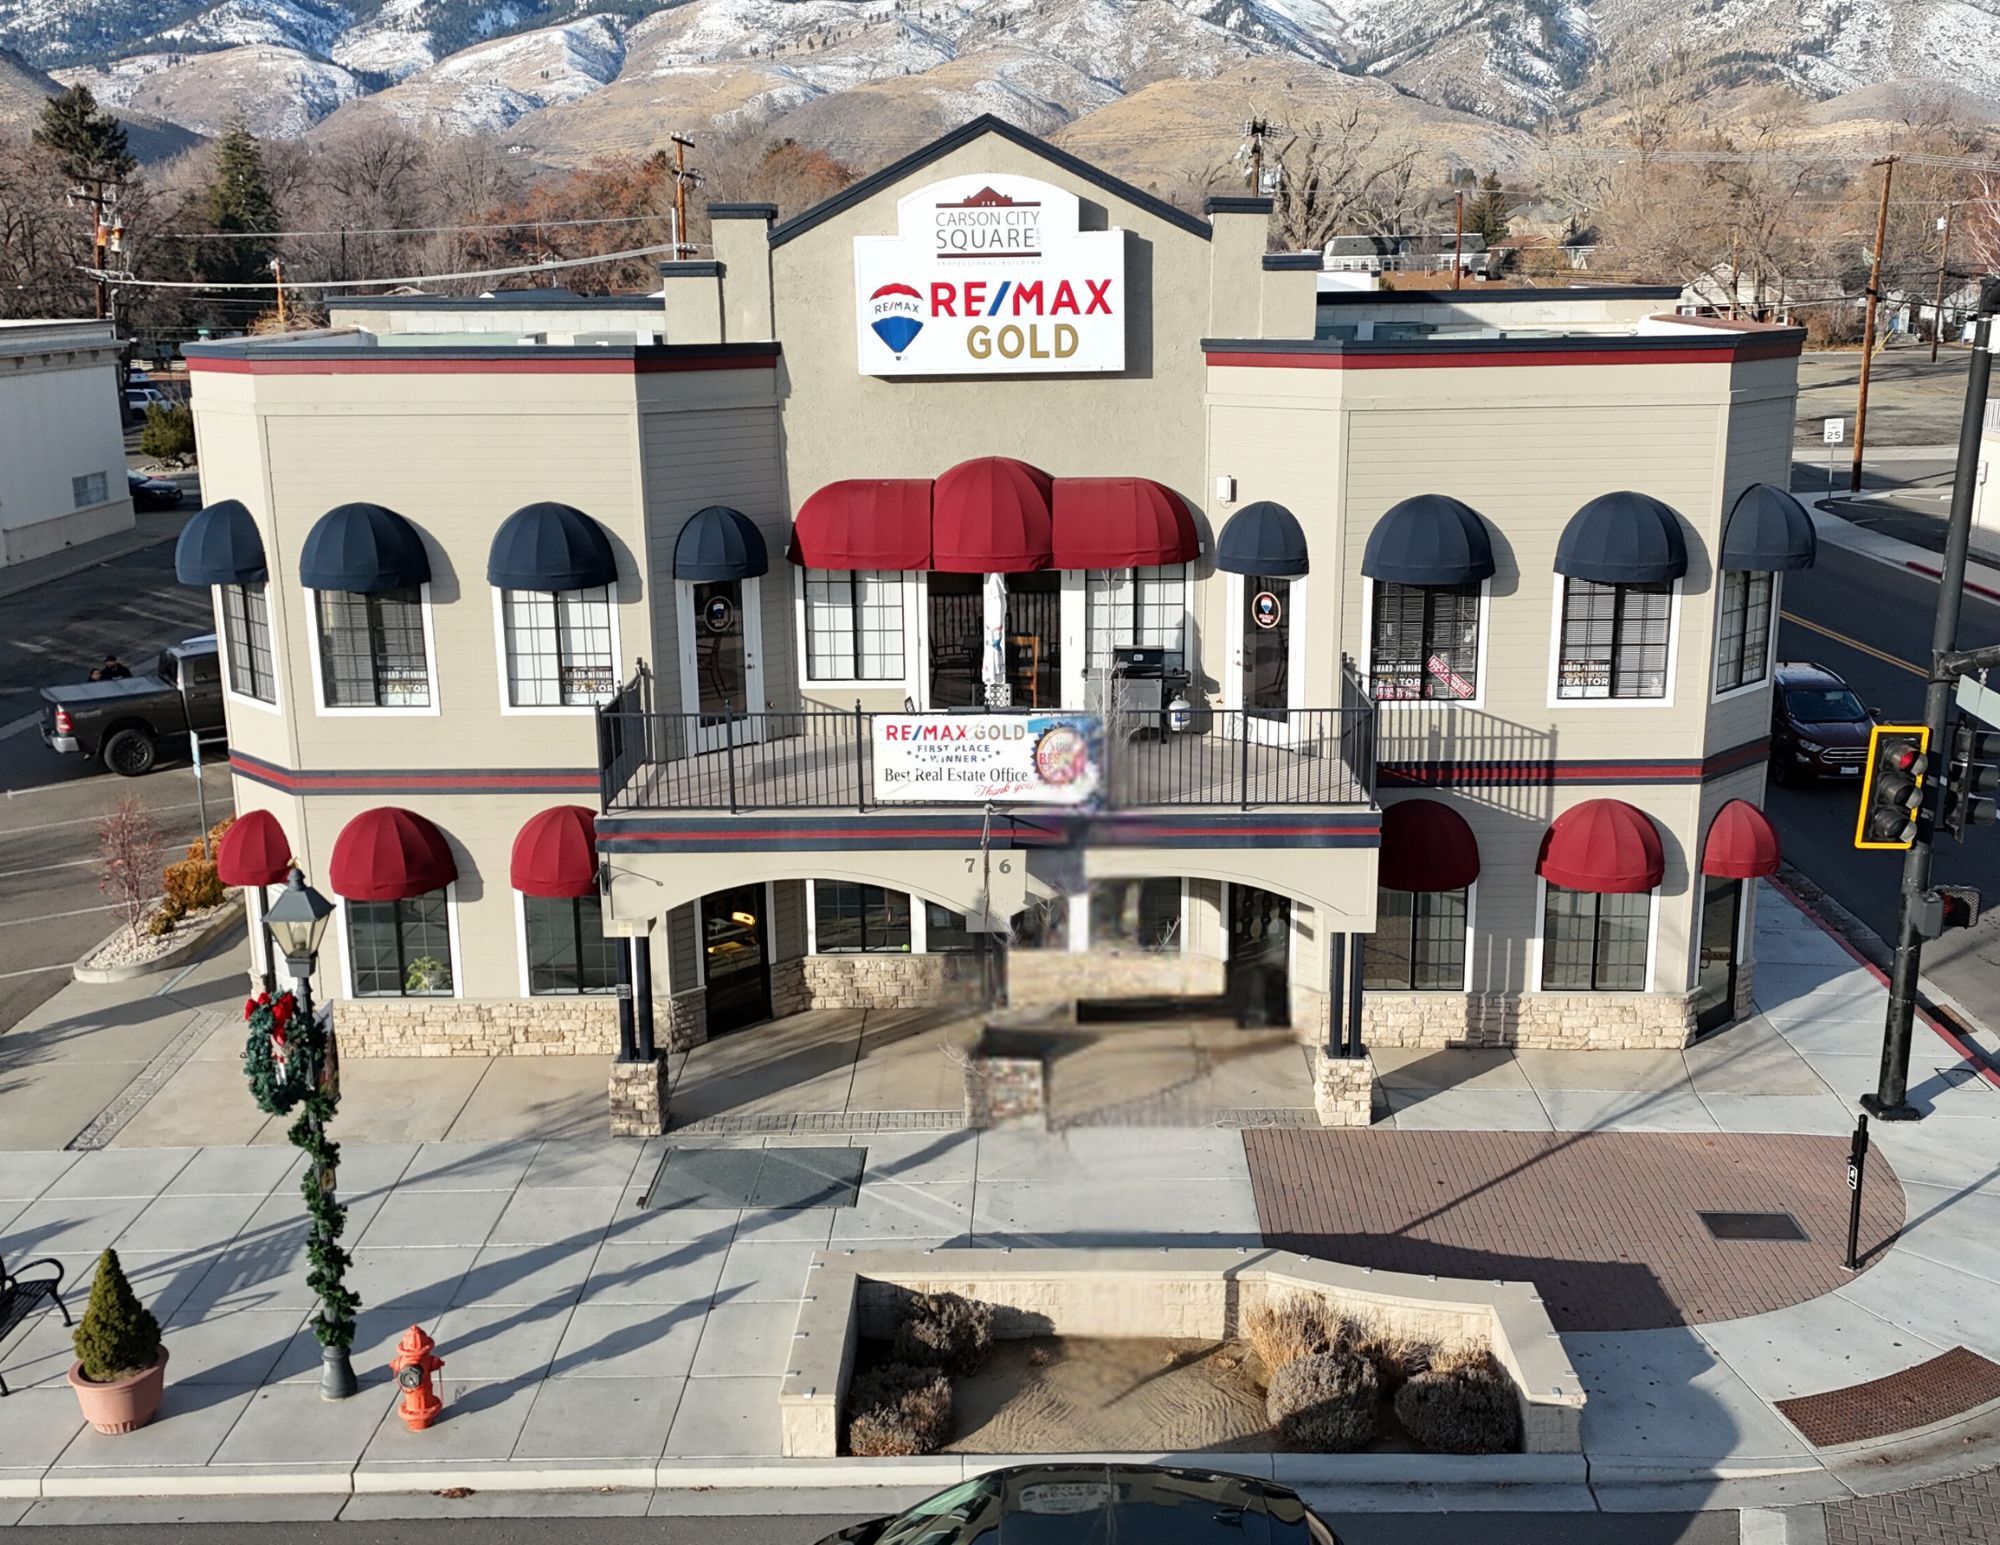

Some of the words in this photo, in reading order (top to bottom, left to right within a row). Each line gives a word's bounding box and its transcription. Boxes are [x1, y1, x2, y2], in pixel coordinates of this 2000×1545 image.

[936, 211, 1000, 226] CARSON
[1005, 210, 1040, 226] CITY
[936, 228, 1035, 251] SQUARE
[930, 279, 1113, 317] RE/MAX
[875, 301, 920, 314] RE/MAX
[967, 323, 1079, 359] GOLD
[1827, 431, 1841, 440] 25
[1560, 678, 1610, 686] REALTOR
[886, 725, 967, 741] RE/MAX
[974, 725, 1025, 741] GOLD
[917, 744, 949, 753] FIRST
[954, 744, 991, 753] PLACE
[885, 767, 911, 783] Best
[915, 766, 944, 782] Real
[947, 767, 986, 782] Estate
[989, 767, 1028, 783] Office
[974, 782, 1011, 797] Thank
[964, 857, 1012, 875] 76
